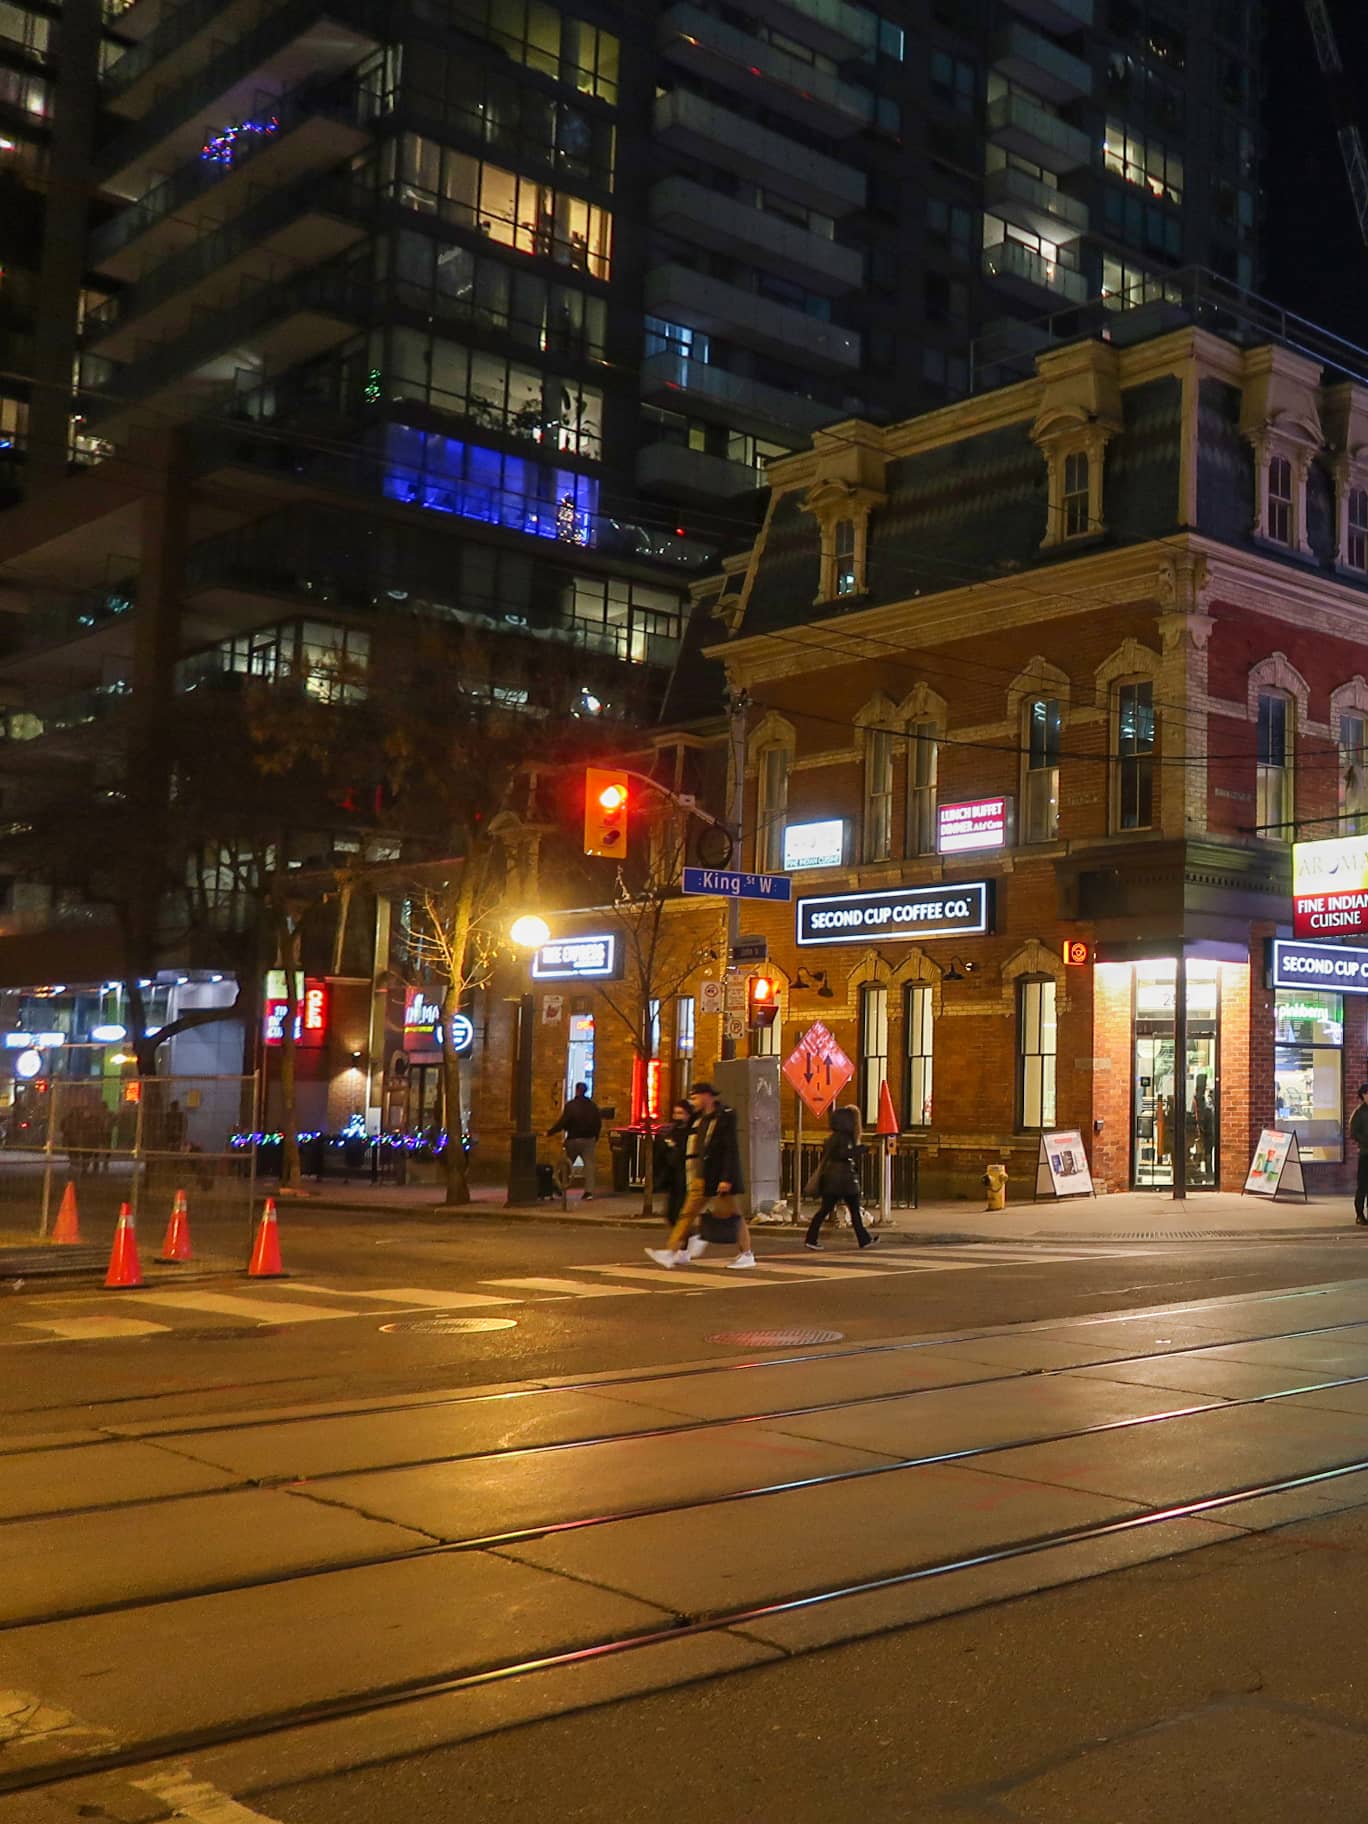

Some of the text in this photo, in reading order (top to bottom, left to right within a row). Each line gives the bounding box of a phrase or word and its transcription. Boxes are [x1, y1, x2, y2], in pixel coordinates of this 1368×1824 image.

[703, 872, 772, 895] King St W
[811, 910, 863, 929] SECOND
[863, 906, 891, 925] CUP
[892, 902, 943, 922] COFFEE
[1297, 898, 1325, 913] FINE
[1310, 911, 1362, 928] CUISINE
[1282, 956, 1333, 975] SECOND
[1334, 960, 1359, 977] CUP
